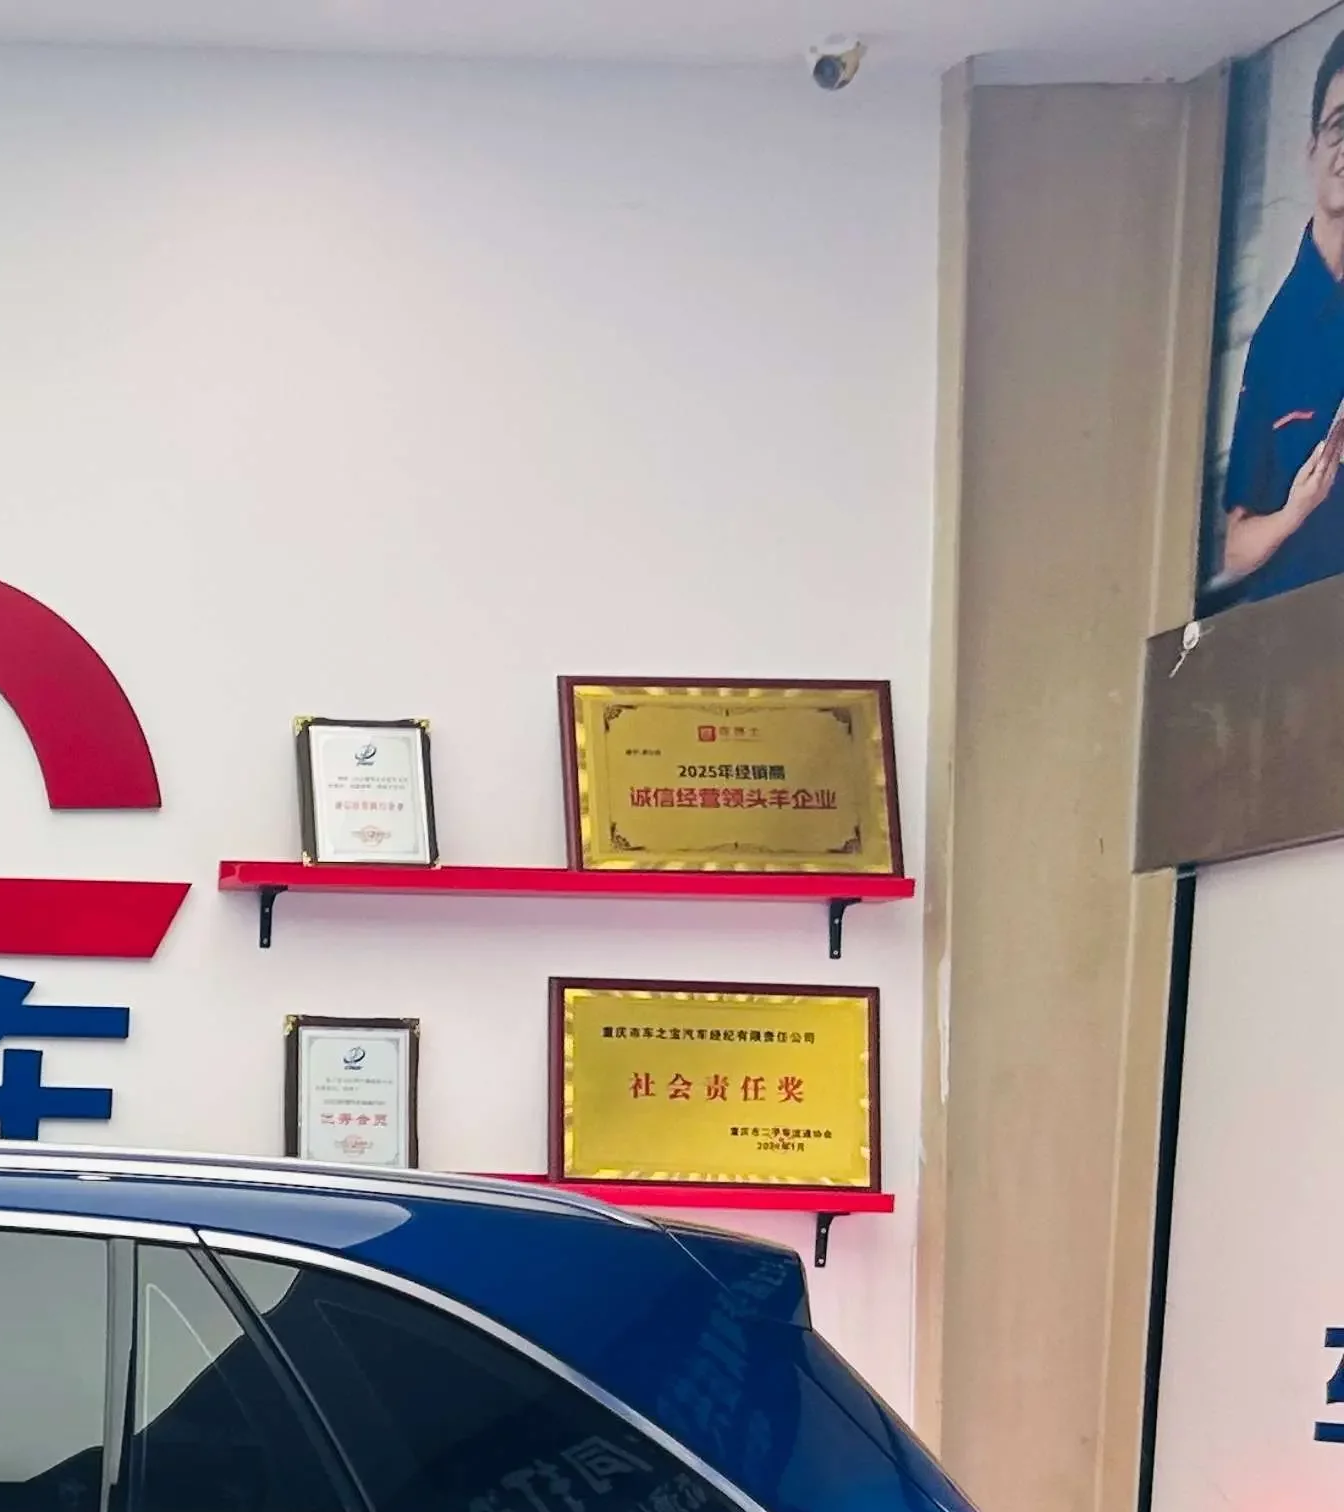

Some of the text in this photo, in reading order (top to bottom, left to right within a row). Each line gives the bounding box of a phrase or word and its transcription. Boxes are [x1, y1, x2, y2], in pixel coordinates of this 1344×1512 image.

[629, 786, 837, 809] 诚信经营领头羊企业
[601, 1026, 815, 1044] 重庆市车之宝汽车经纪有限责任公司
[629, 1072, 805, 1103] 社会责任奖
